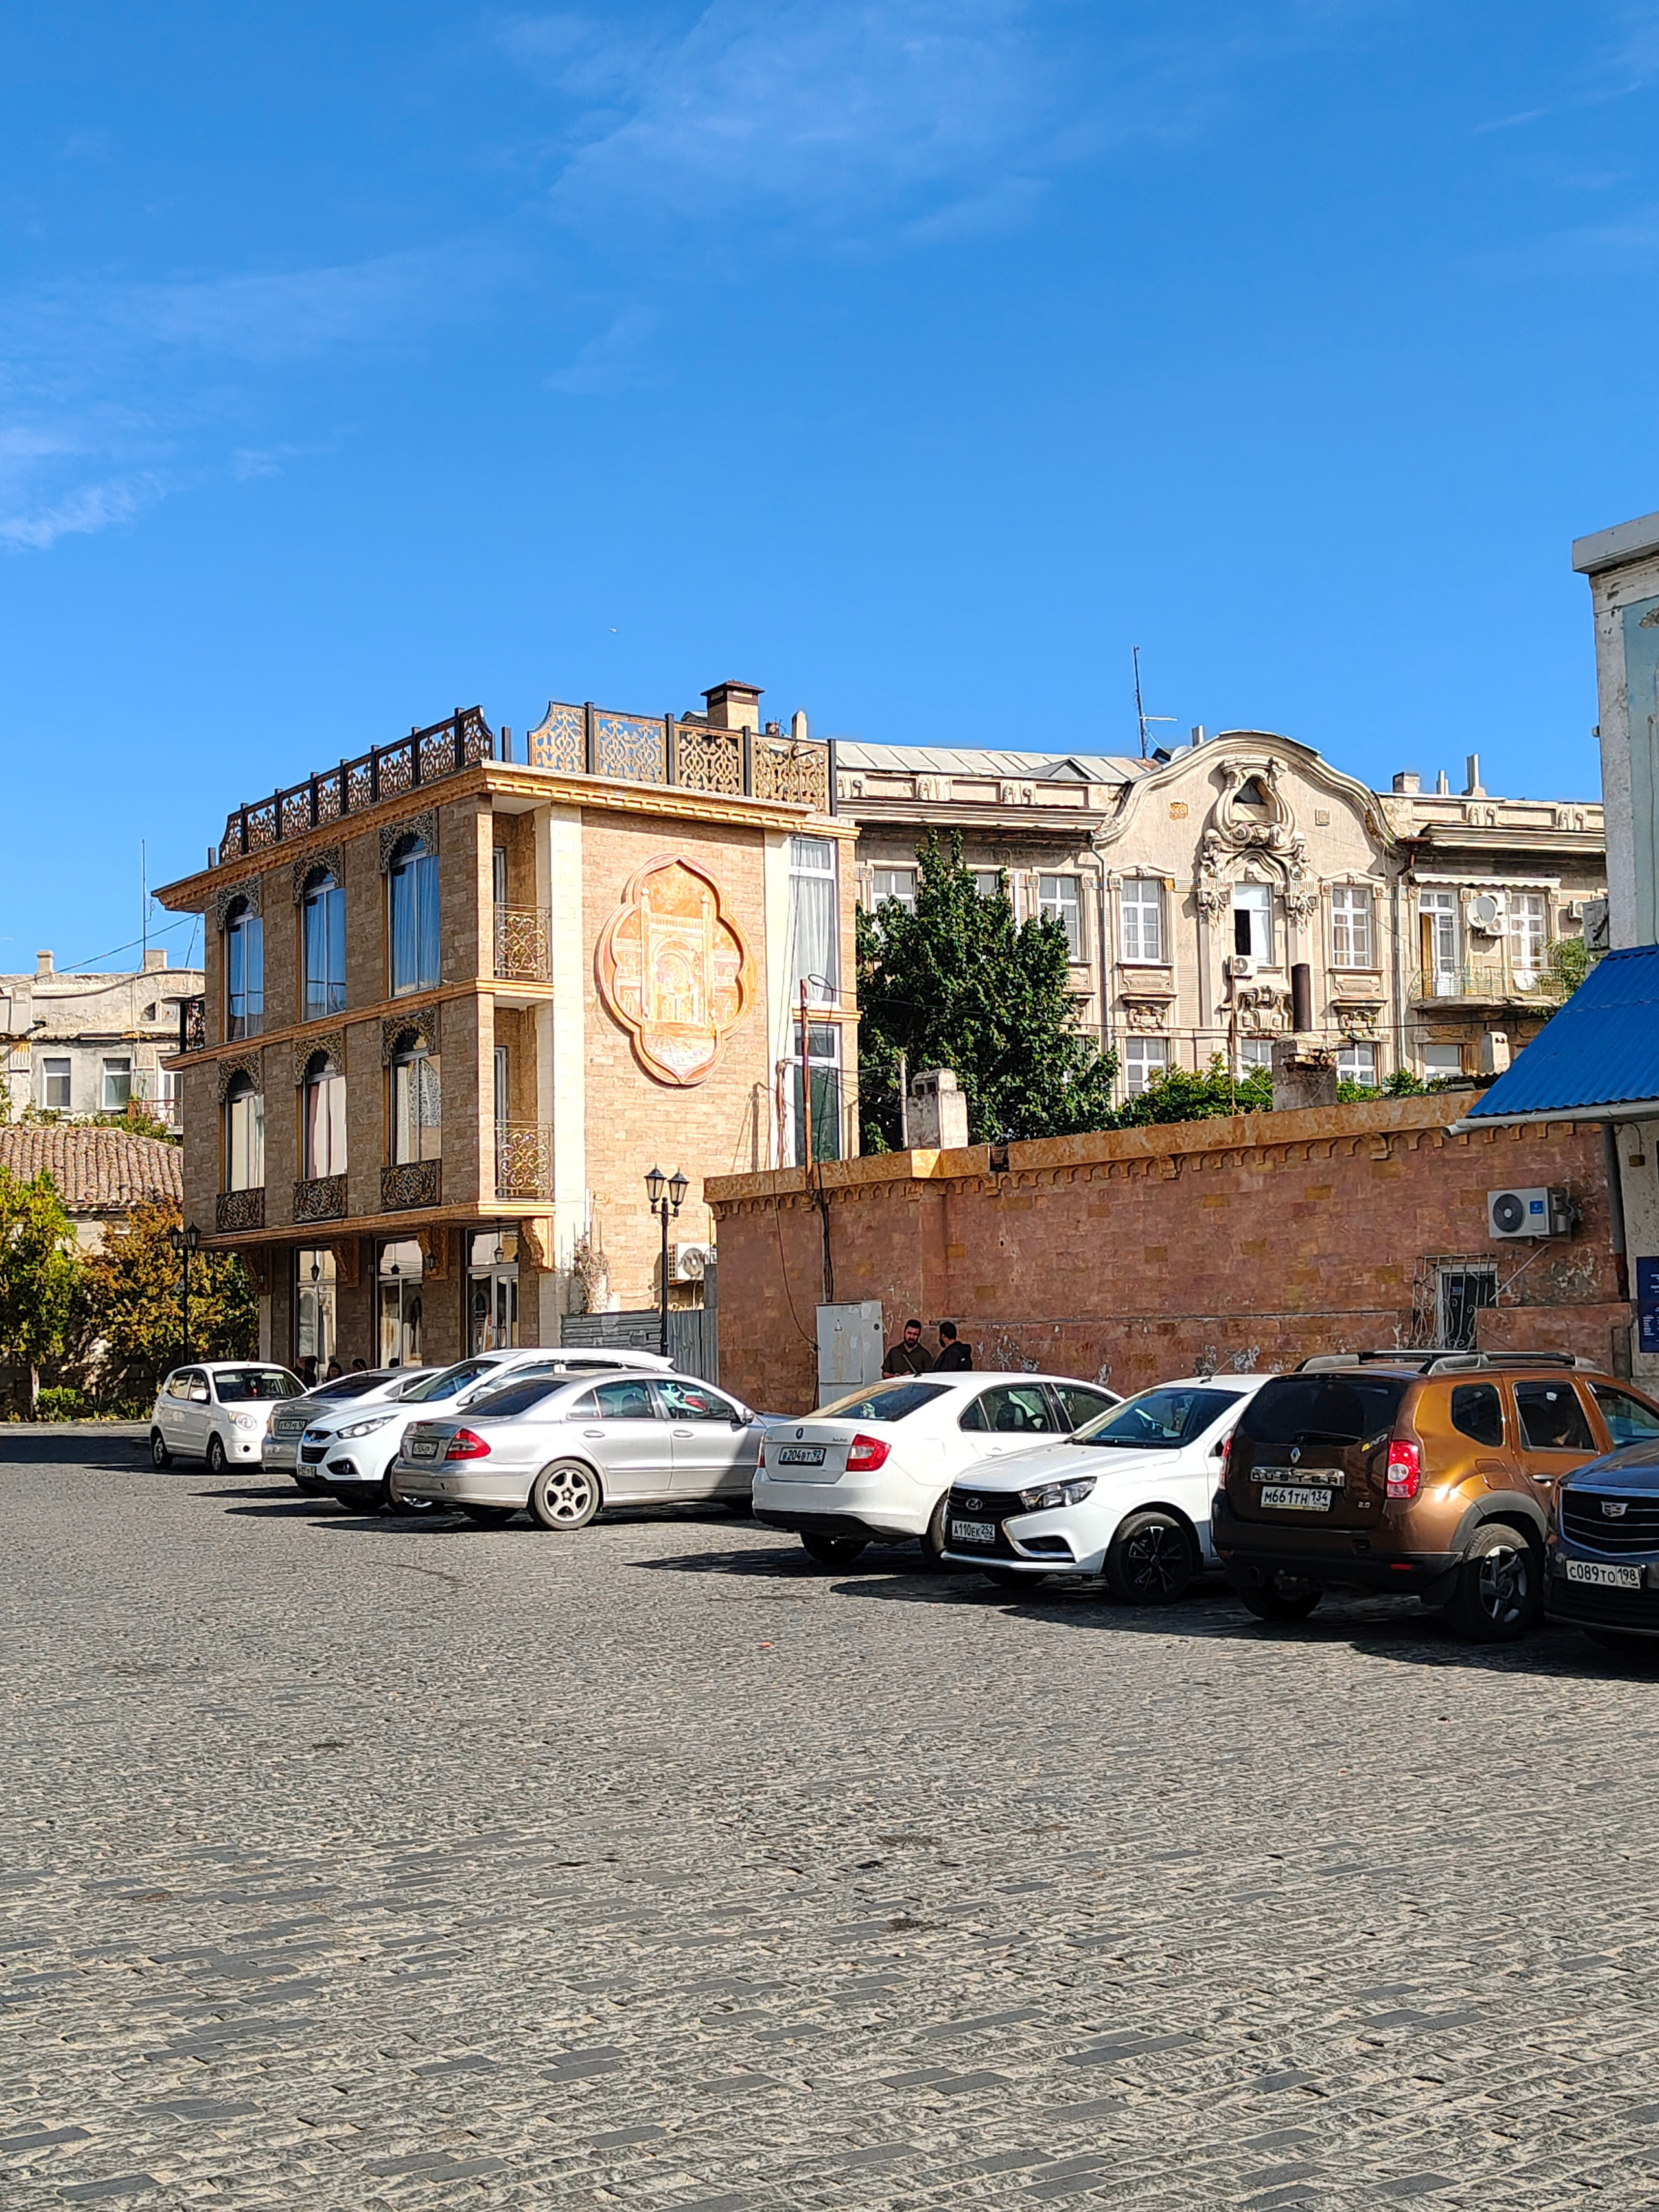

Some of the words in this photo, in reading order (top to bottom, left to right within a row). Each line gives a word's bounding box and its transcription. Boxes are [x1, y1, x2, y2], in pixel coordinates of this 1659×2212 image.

[1252, 1472, 1338, 1484] DUSTER
[1264, 1488, 1308, 1506] М661ТН
[1311, 1490, 1328, 1502] 134
[1569, 1563, 1616, 1583] С089ТО
[1617, 1568, 1638, 1581] 198
